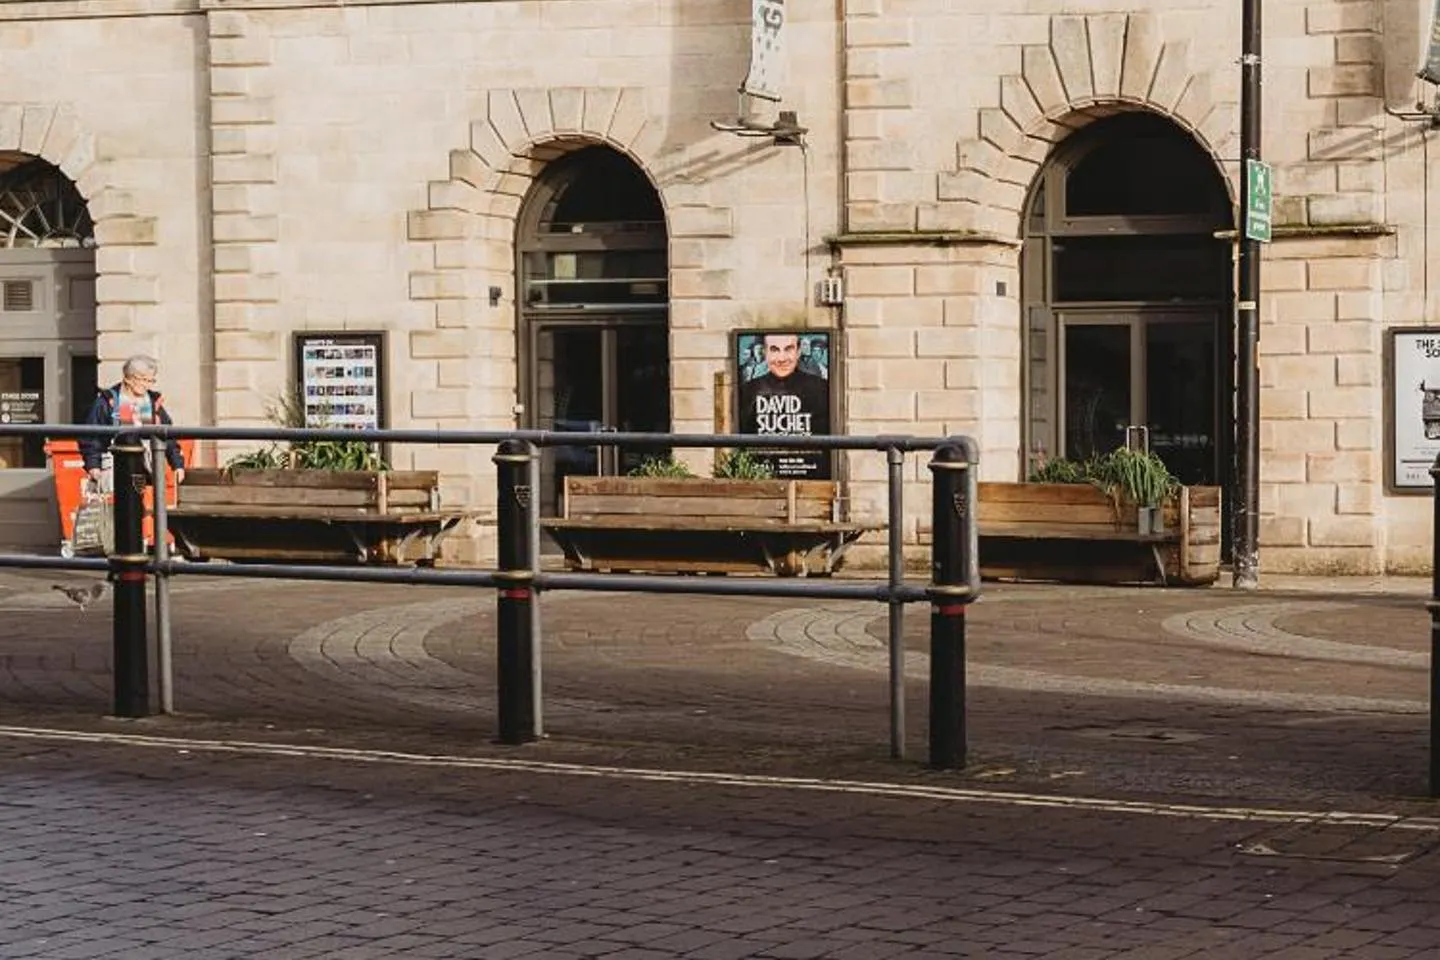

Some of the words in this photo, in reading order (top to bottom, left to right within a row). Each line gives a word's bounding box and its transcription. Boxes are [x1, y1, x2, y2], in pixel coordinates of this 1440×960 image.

[1416, 339, 1435, 349] THE
[1425, 348, 1440, 358] SO
[756, 395, 801, 413] DAVID
[756, 413, 811, 431] SUCHET
